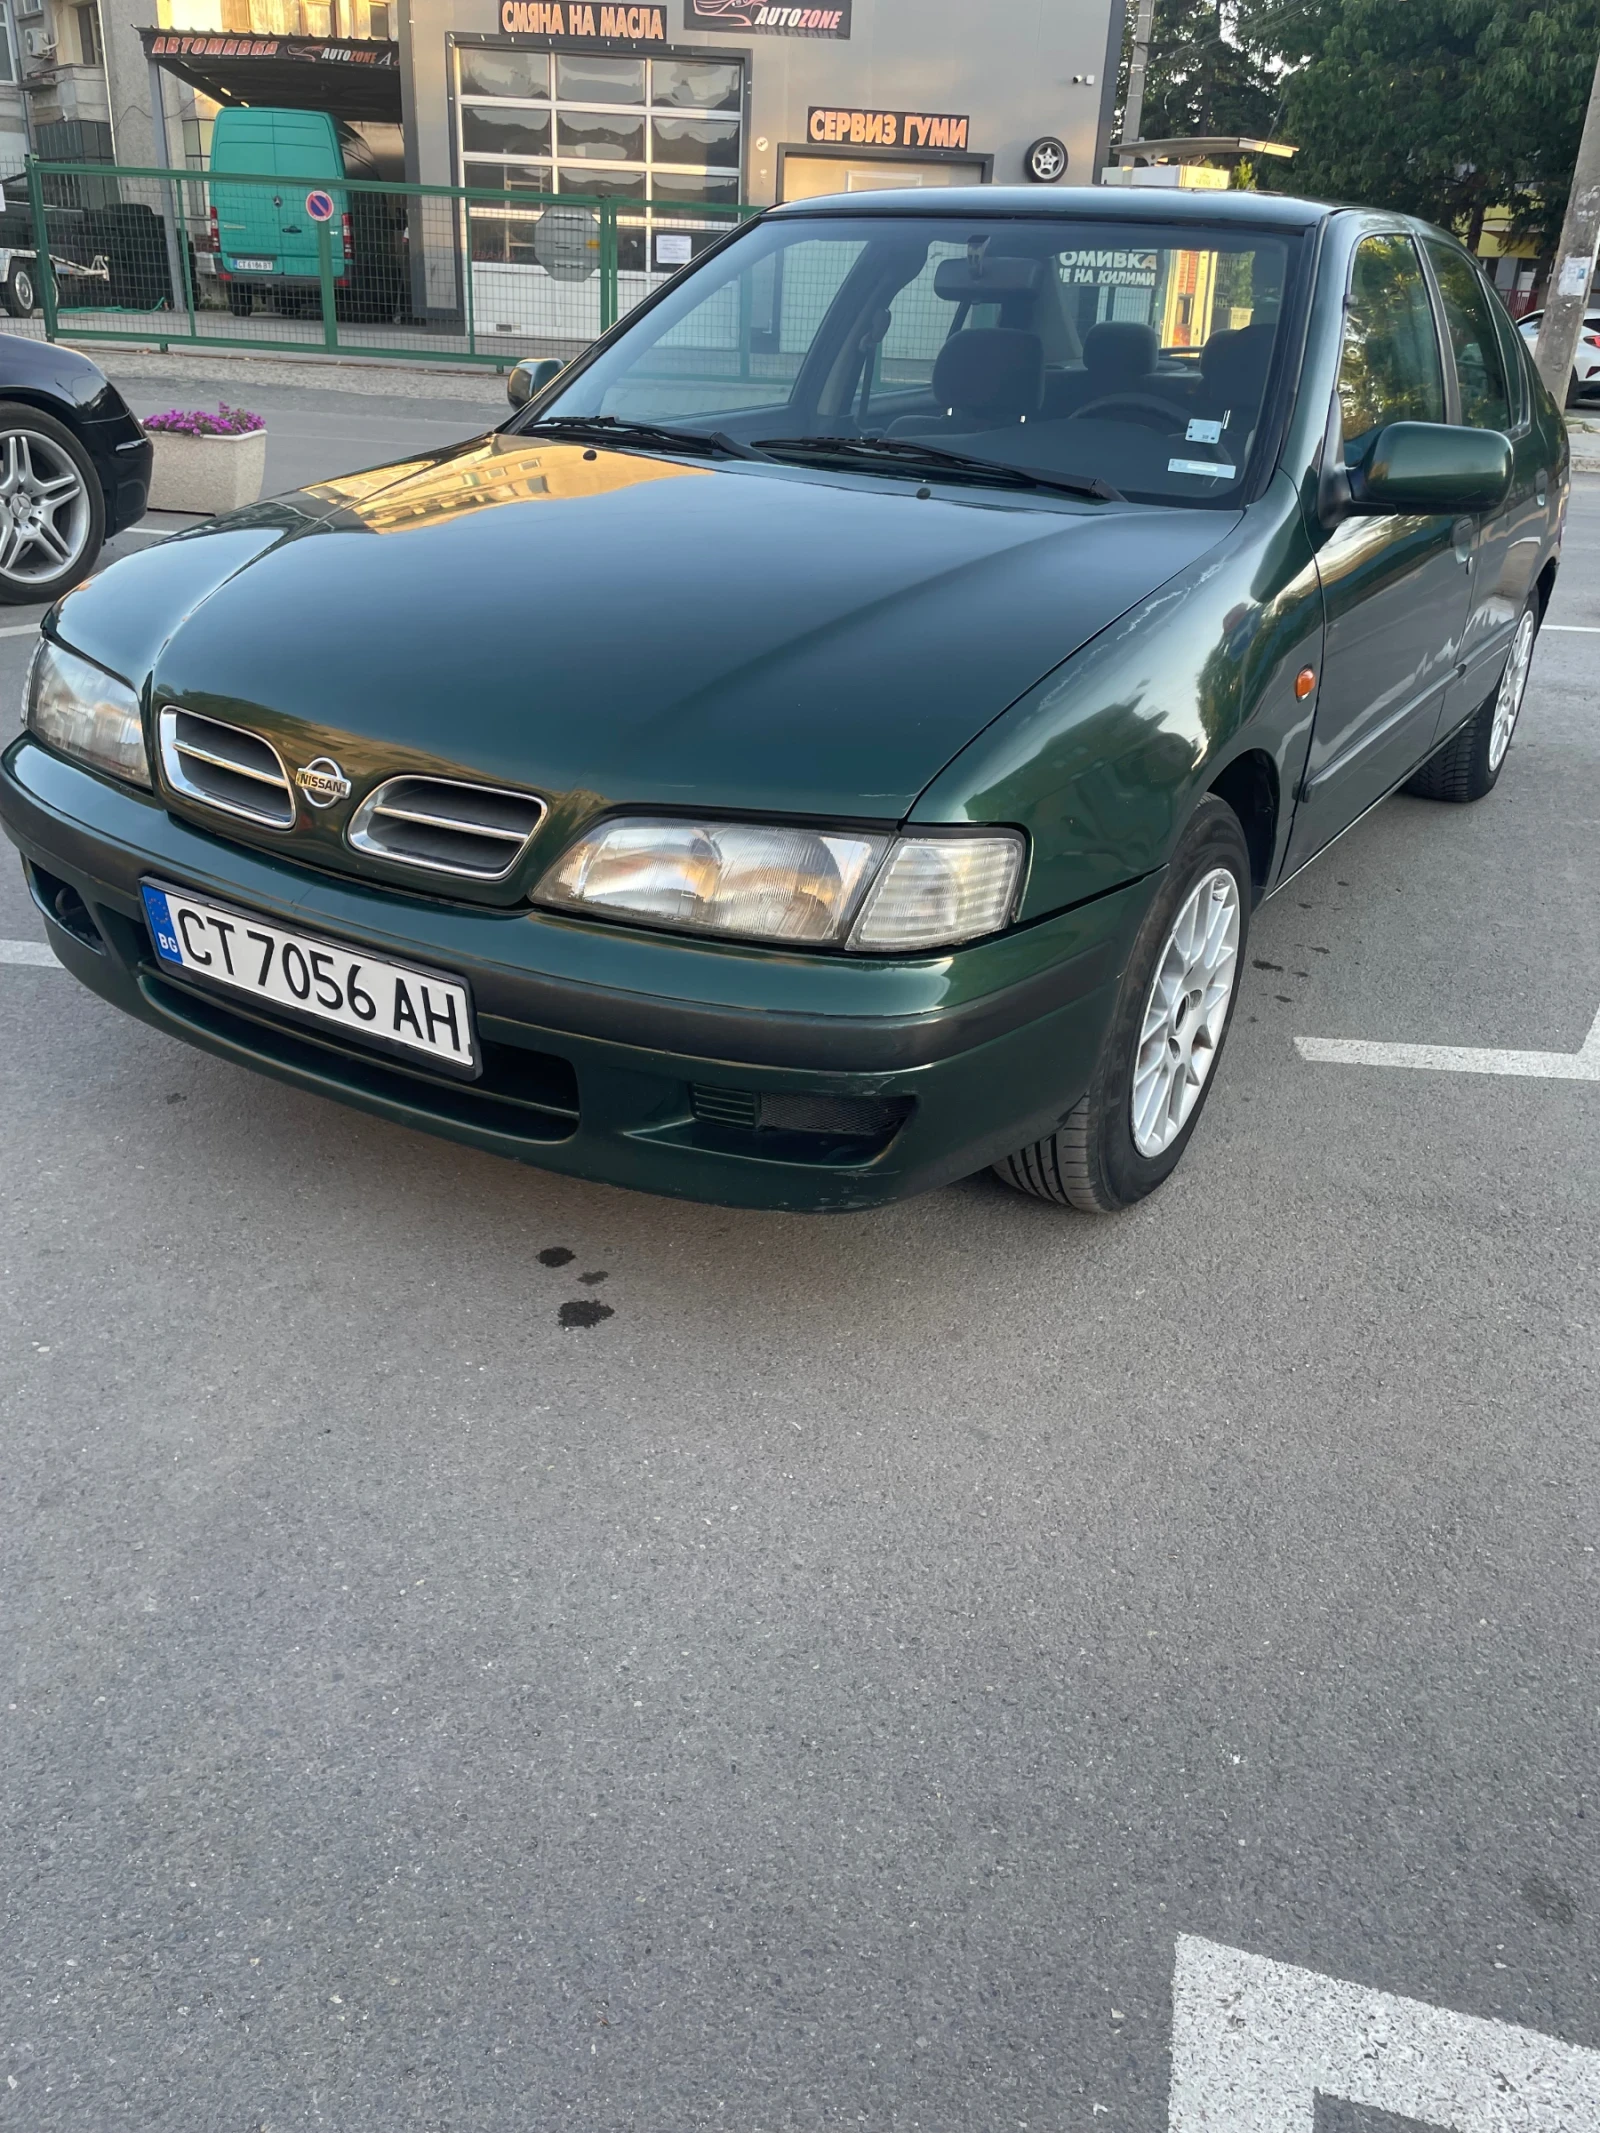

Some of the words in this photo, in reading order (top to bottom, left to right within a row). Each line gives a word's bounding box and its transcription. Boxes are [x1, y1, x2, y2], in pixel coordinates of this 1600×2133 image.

[501, 1, 565, 35] СМЯНА
[569, 4, 596, 36] НА
[600, 6, 664, 40] МАСЛА
[754, 6, 843, 29] AUTOZONE
[151, 36, 280, 56] АВТОМИВКА
[321, 47, 378, 64] AUTOZONE
[810, 110, 897, 145] СЕРВИЗ
[903, 115, 968, 148] ГУМИ
[1059, 267, 1071, 283] Е
[1073, 268, 1094, 283] НА
[1097, 270, 1156, 286] КИЛИМИ
[300, 773, 342, 793] NISSAN
[158, 932, 179, 954] BG
[177, 908, 235, 976] CT
[246, 928, 377, 1021] 7056
[393, 975, 461, 1052] AH
